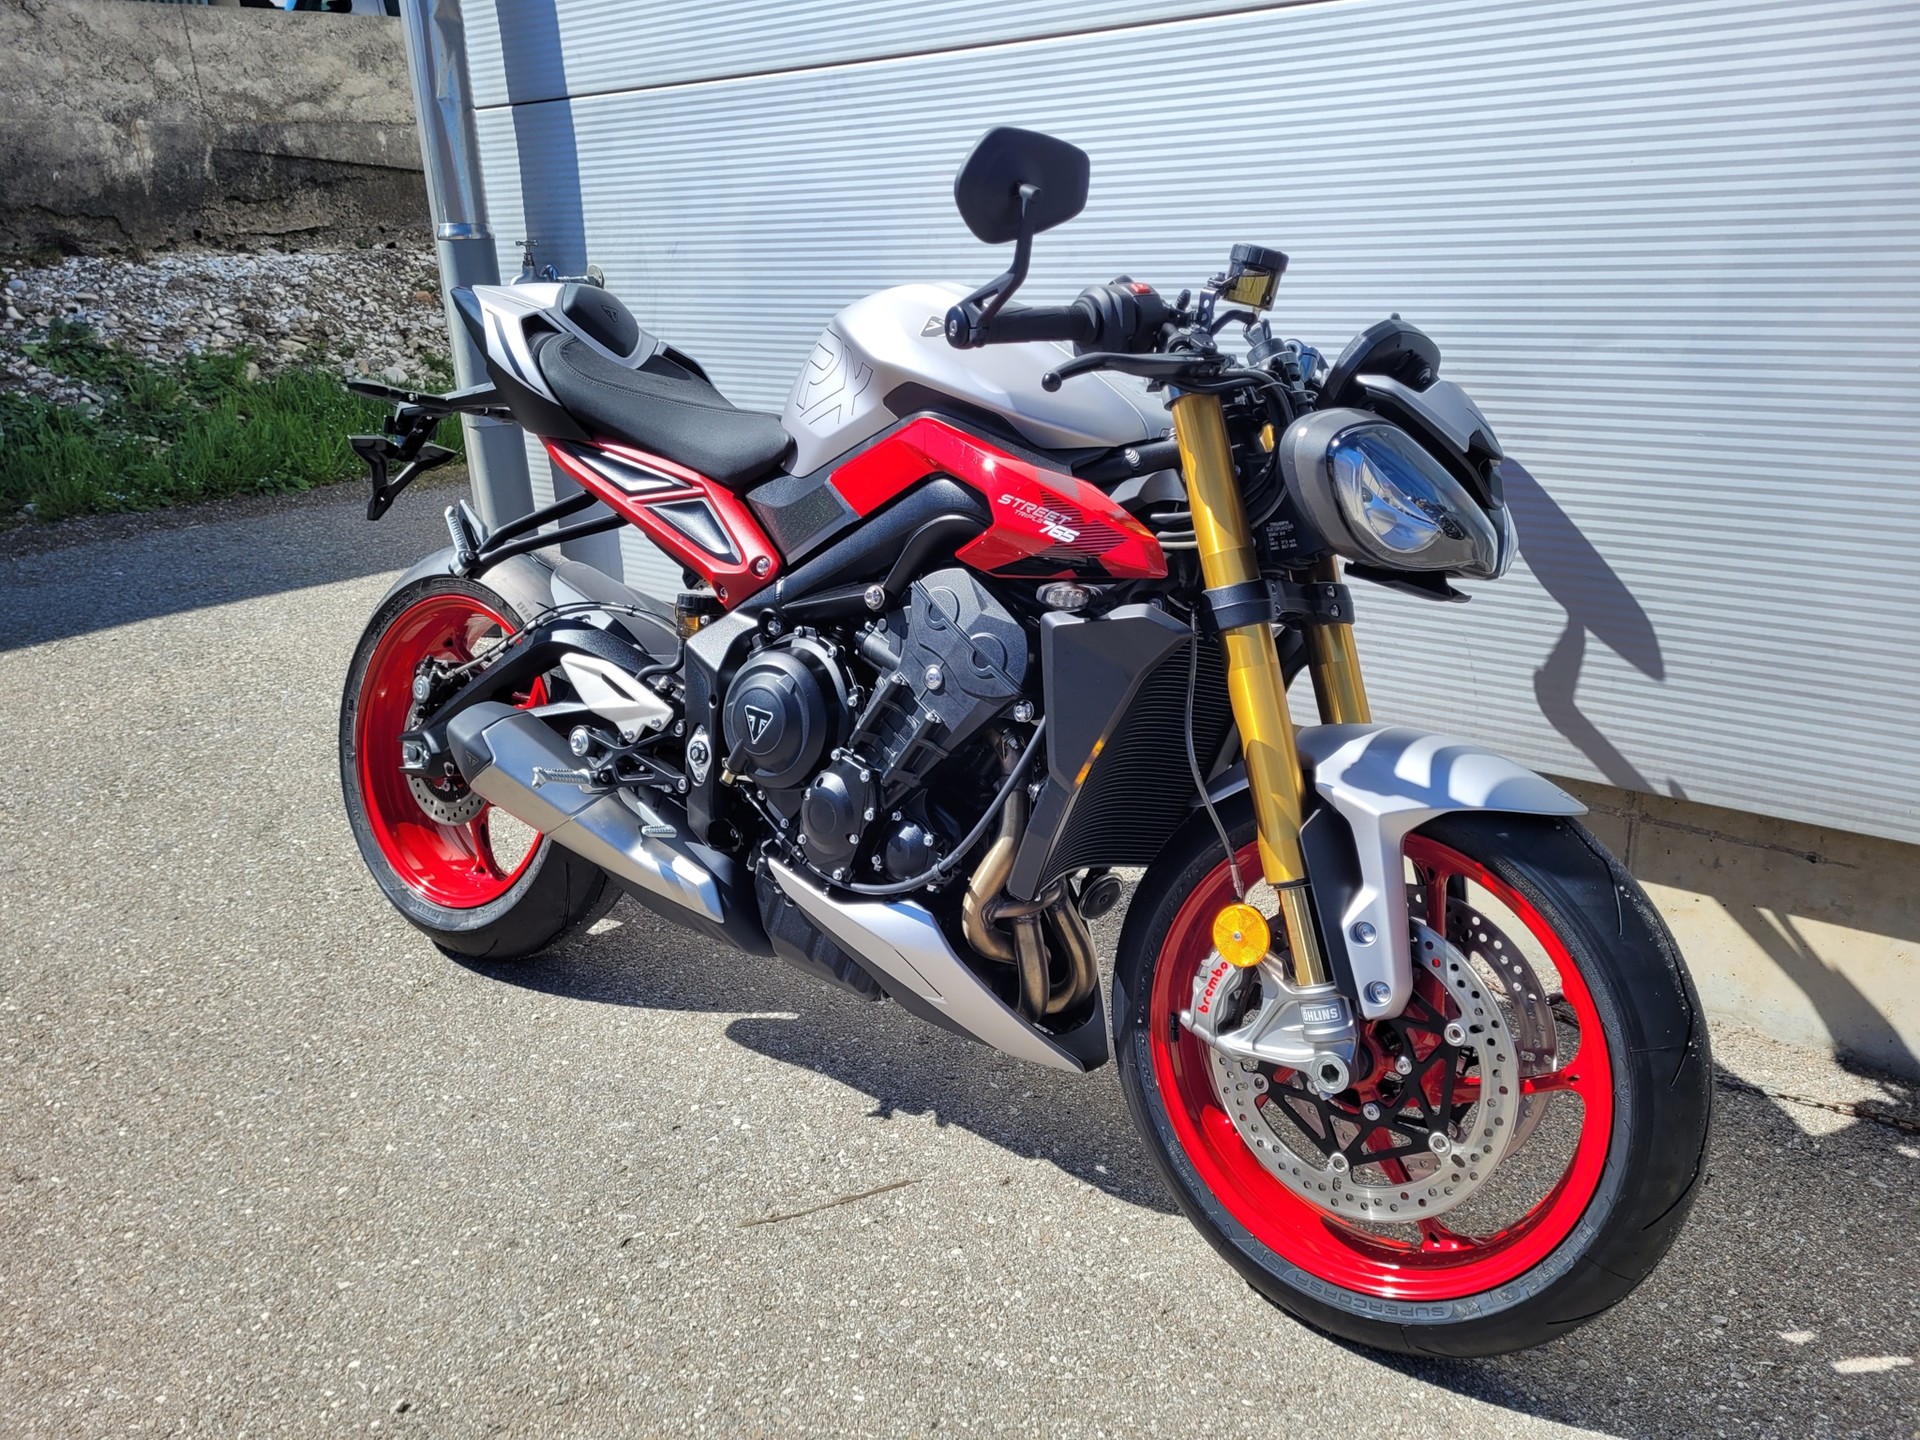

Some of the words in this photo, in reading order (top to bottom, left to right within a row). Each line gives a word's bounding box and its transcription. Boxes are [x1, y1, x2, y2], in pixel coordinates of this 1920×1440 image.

[997, 493, 1073, 525] STREET
[1014, 509, 1044, 525] TRIPLE
[1038, 519, 1081, 543] 765
[1197, 961, 1228, 1014] brembo
[1498, 1223, 1597, 1306] DIABLO
[1293, 1272, 1446, 1318] SUPERCORSA
